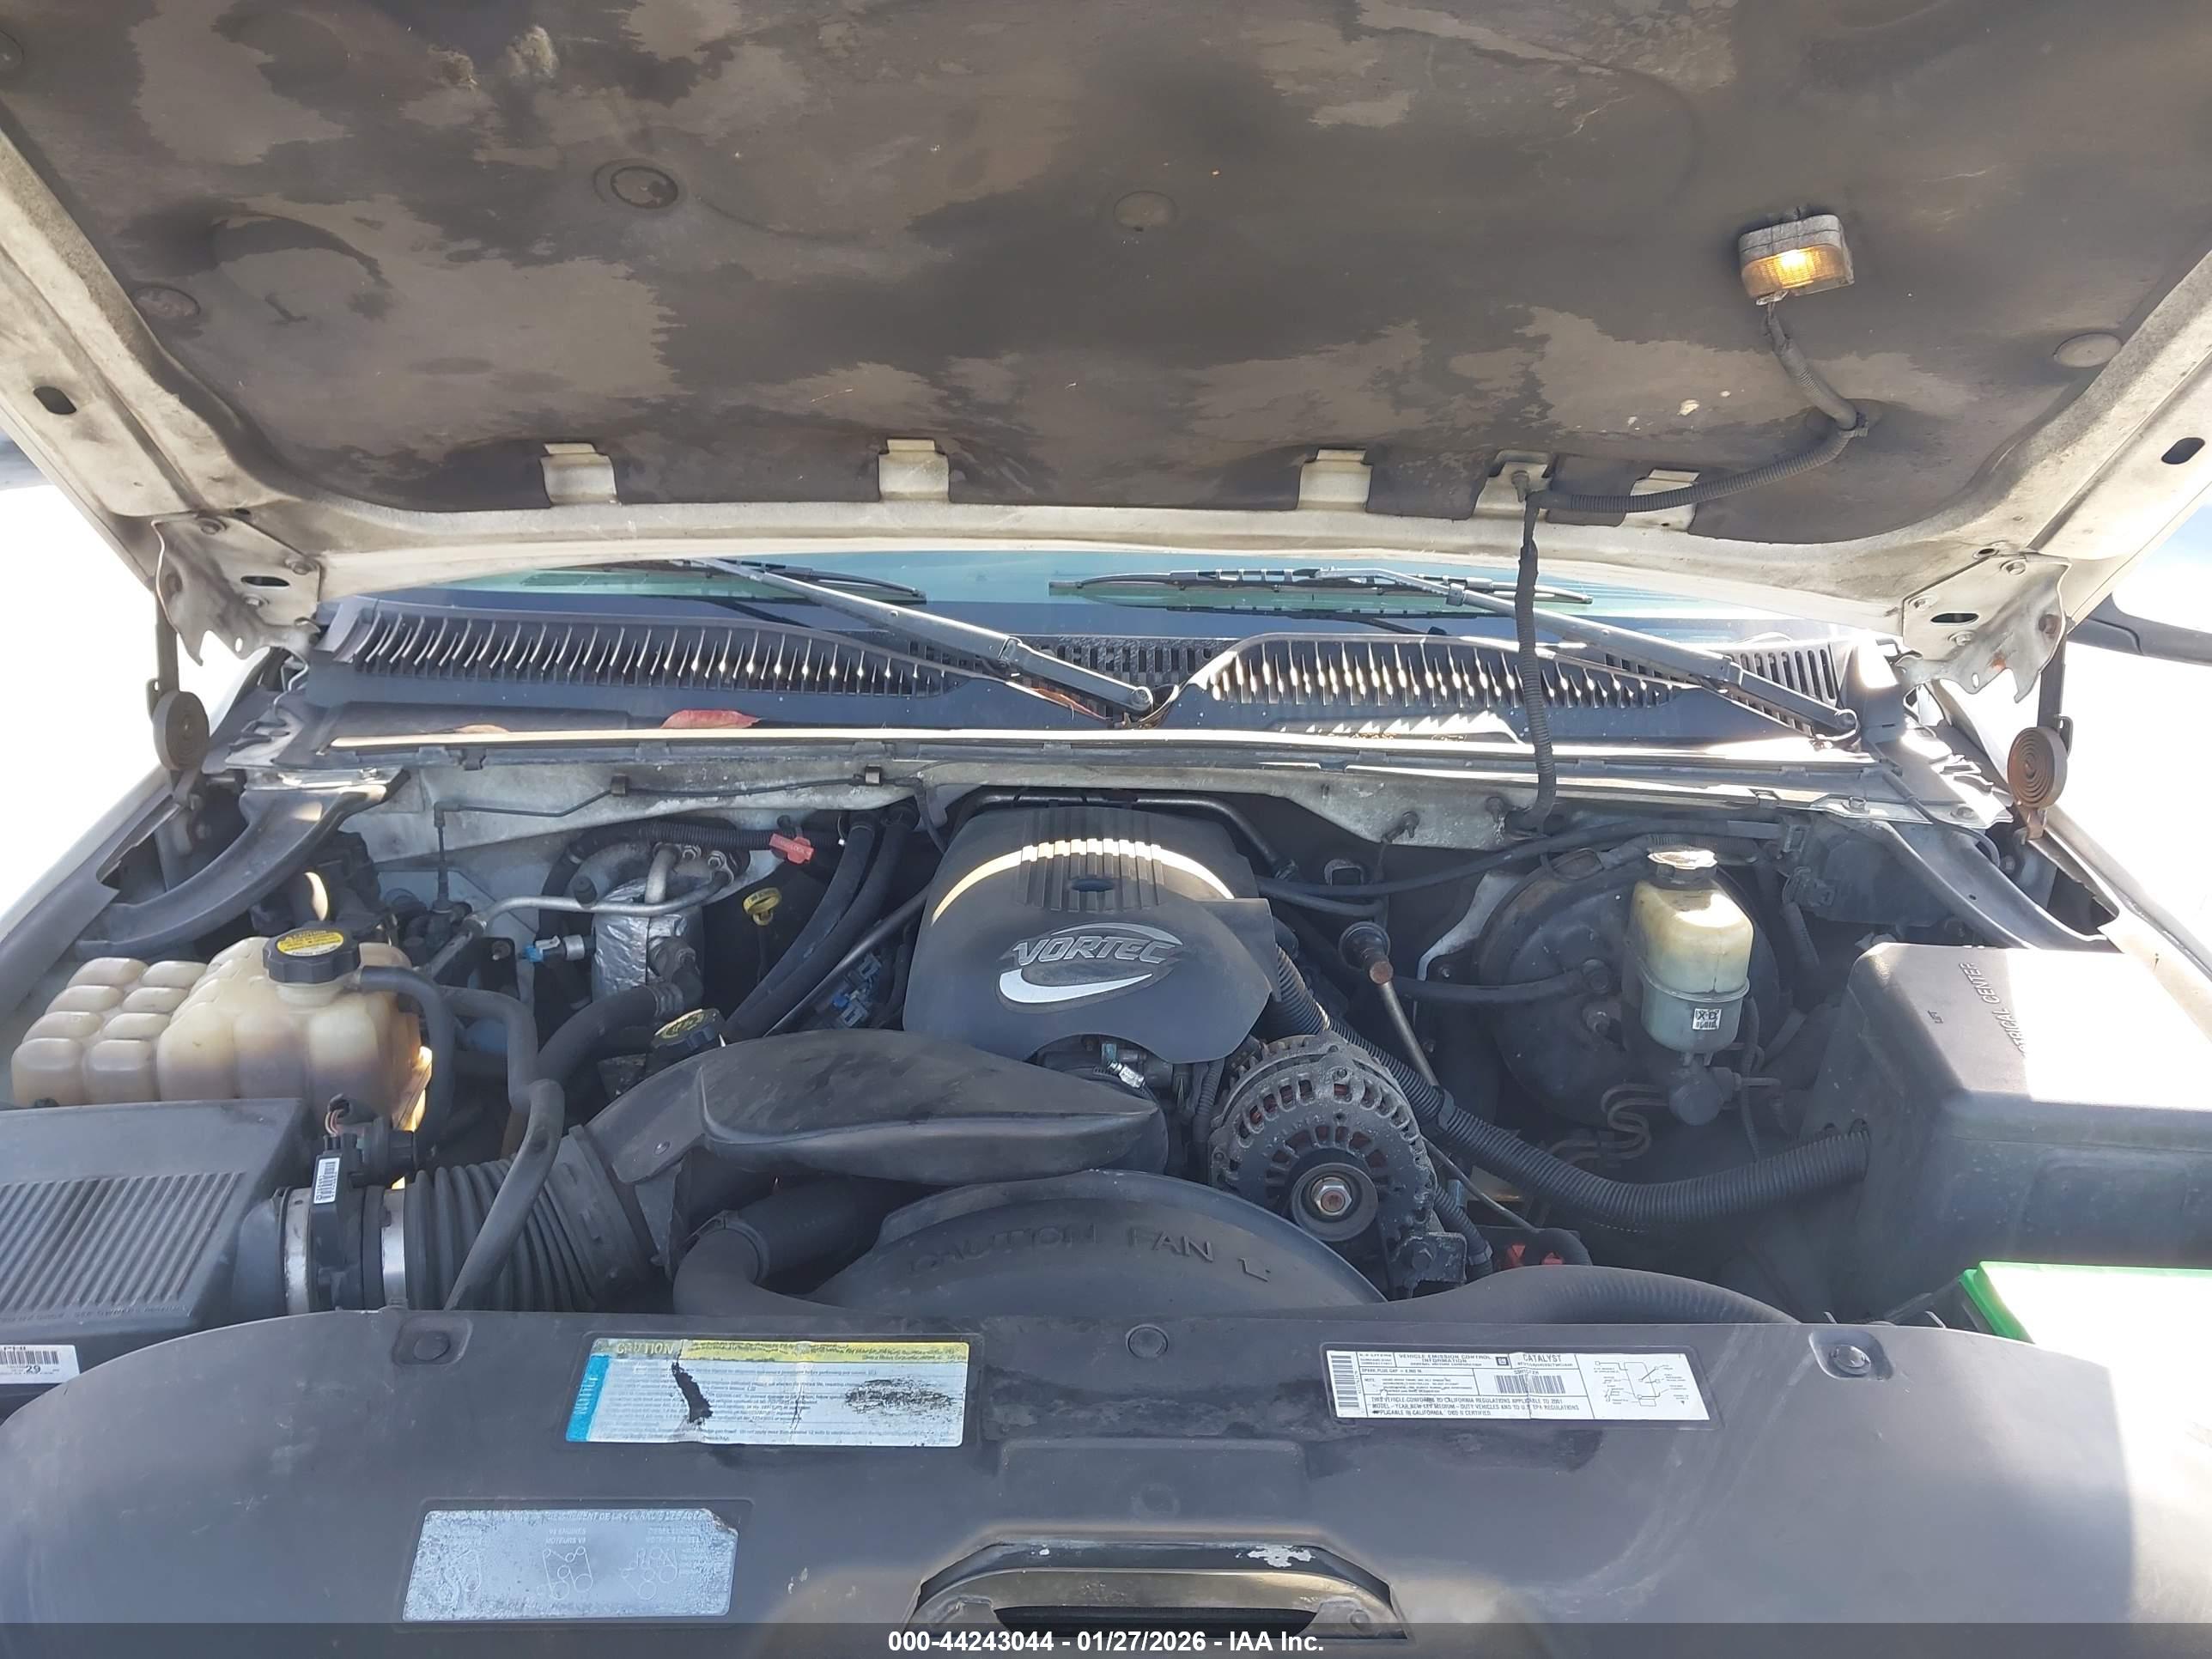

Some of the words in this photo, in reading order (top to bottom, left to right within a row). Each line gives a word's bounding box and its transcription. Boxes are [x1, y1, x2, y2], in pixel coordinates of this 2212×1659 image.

[1012, 935, 1176, 967] VORTEC
[1959, 962, 2001, 1004] CENTER
[908, 1222, 1098, 1279] CAUTION
[1128, 1225, 1214, 1263] FAN
[1522, 1353, 1561, 1363] CATALYST
